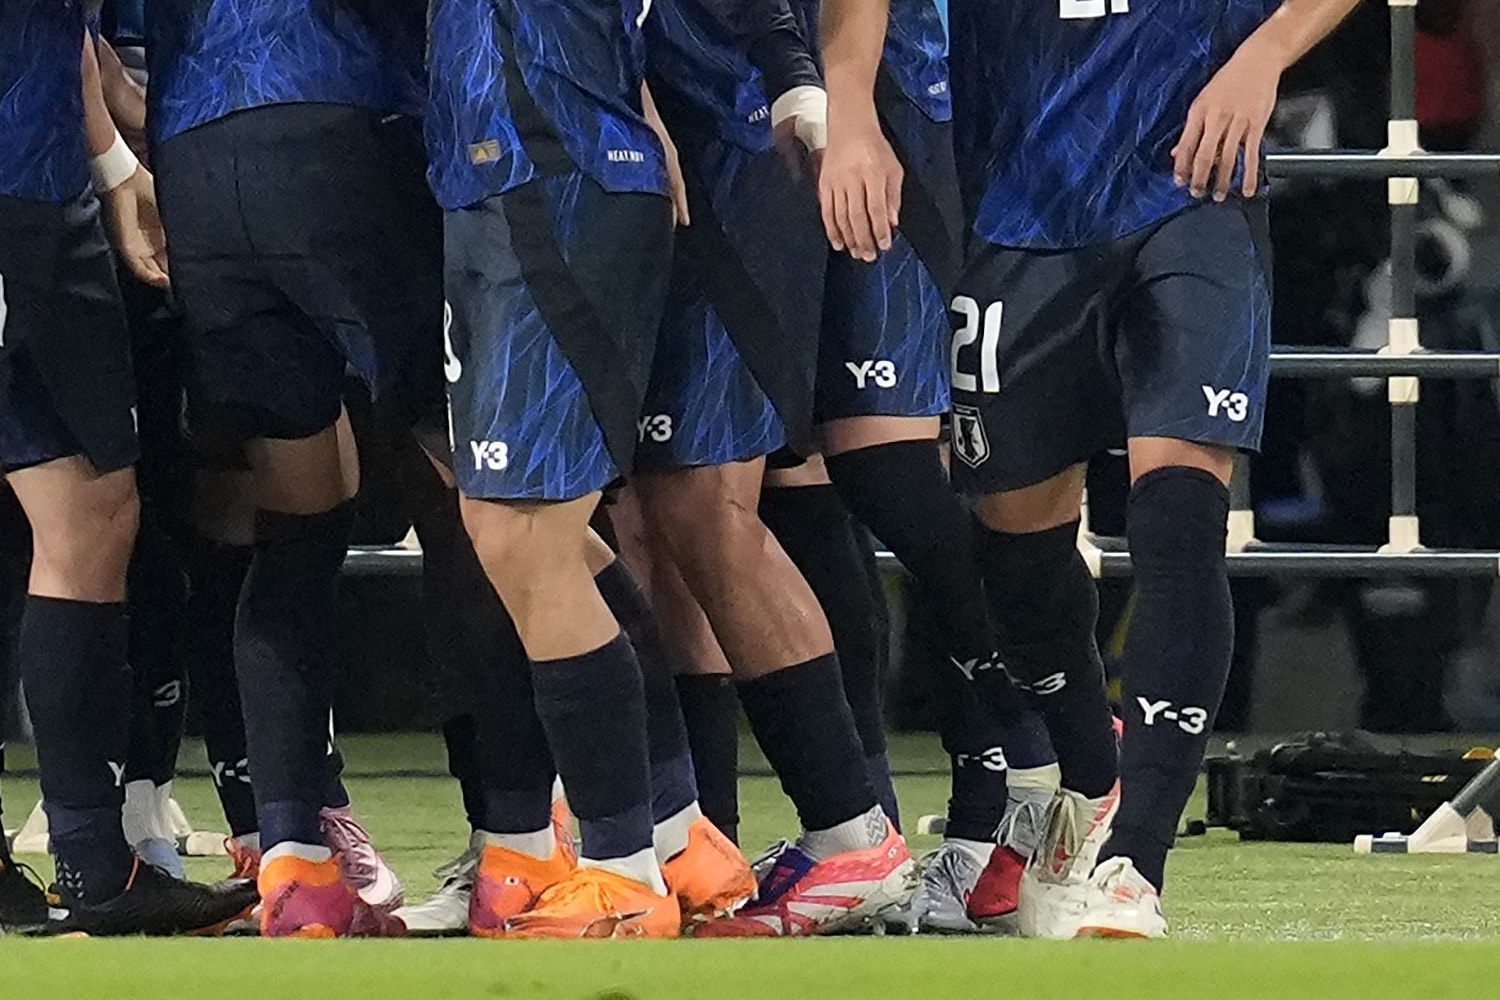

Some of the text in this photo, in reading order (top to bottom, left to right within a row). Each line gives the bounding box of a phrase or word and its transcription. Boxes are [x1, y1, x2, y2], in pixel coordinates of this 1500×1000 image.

[950, 295, 1003, 393] 21
[845, 360, 897, 390] Y-3
[1202, 385, 1249, 422] Y-3
[470, 441, 508, 470] Y-3
[1136, 697, 1209, 735] Y-3
